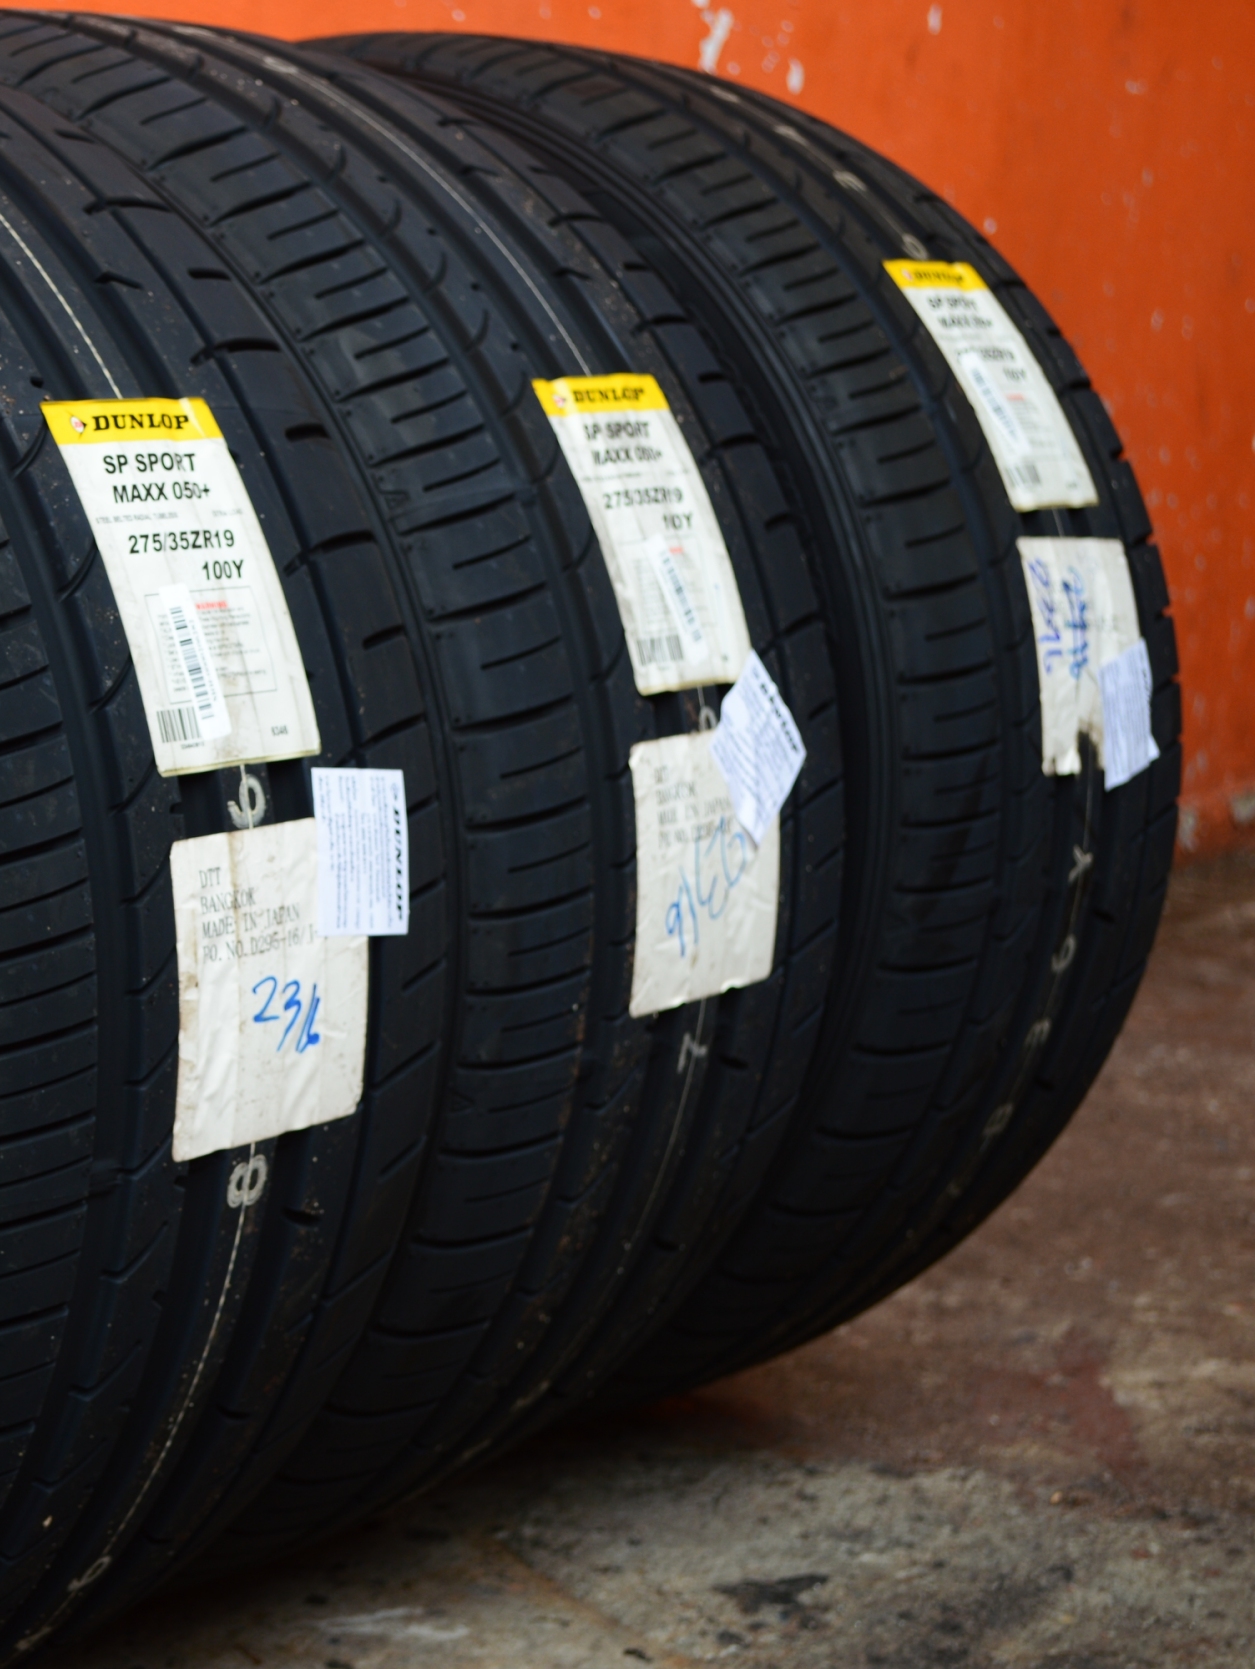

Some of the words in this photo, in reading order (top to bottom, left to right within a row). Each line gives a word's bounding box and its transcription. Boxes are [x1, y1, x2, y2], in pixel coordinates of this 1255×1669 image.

[573, 389, 644, 402] DUNLOP
[92, 414, 189, 431] DUNLOP
[584, 423, 601, 440] SP
[103, 454, 128, 474] SP
[136, 452, 196, 473] SPORT
[113, 482, 169, 504] MAXX
[173, 481, 210, 499] 050+
[128, 530, 234, 554] 275/35ZR19
[202, 559, 244, 581] 100Y
[199, 866, 221, 889] DTT
[200, 886, 256, 915] BANGKOK
[202, 921, 235, 940] MADE
[243, 912, 258, 930] IN
[264, 904, 300, 929] JAPAN
